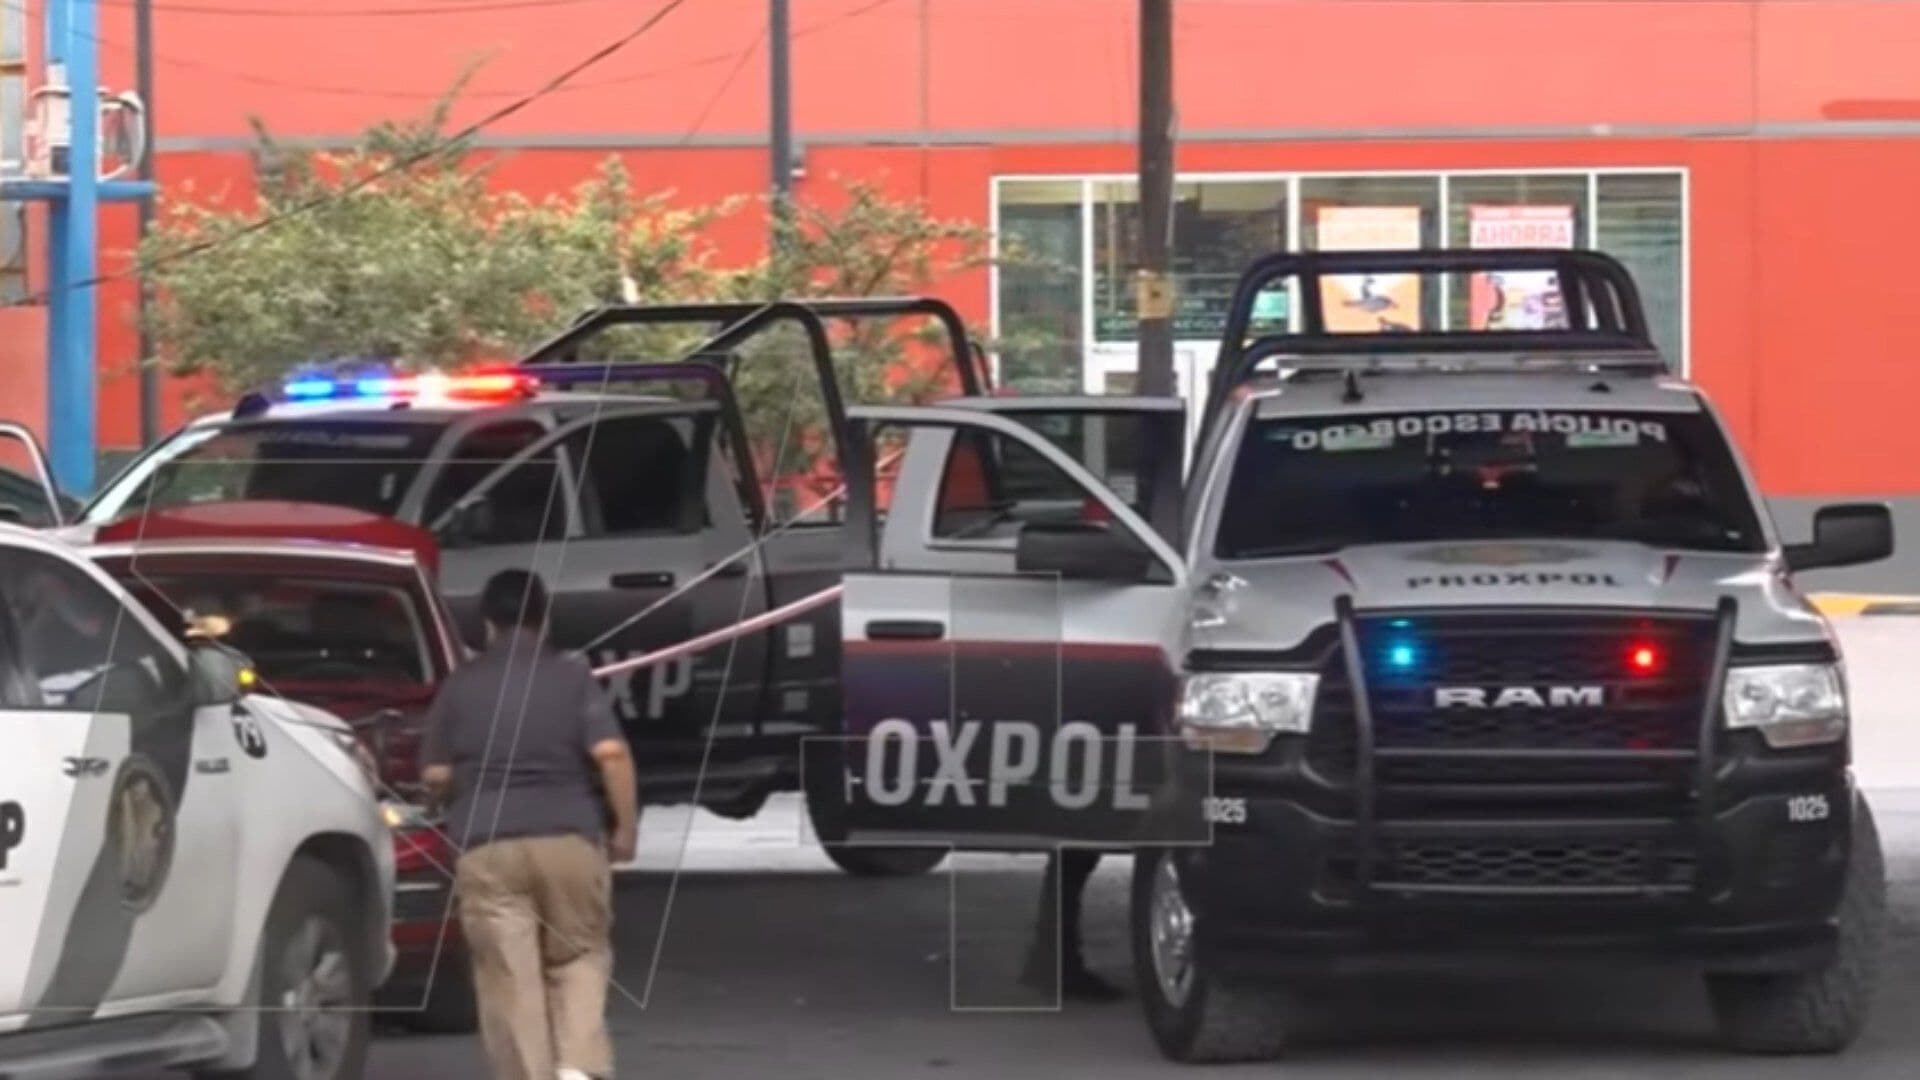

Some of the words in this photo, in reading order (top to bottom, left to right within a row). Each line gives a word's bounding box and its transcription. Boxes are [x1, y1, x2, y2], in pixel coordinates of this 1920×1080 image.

[1476, 224, 1569, 244] AHORRA
[1406, 571, 1623, 590] PROXPOL
[1434, 686, 1603, 708] RAM
[1786, 793, 1831, 822] 1025
